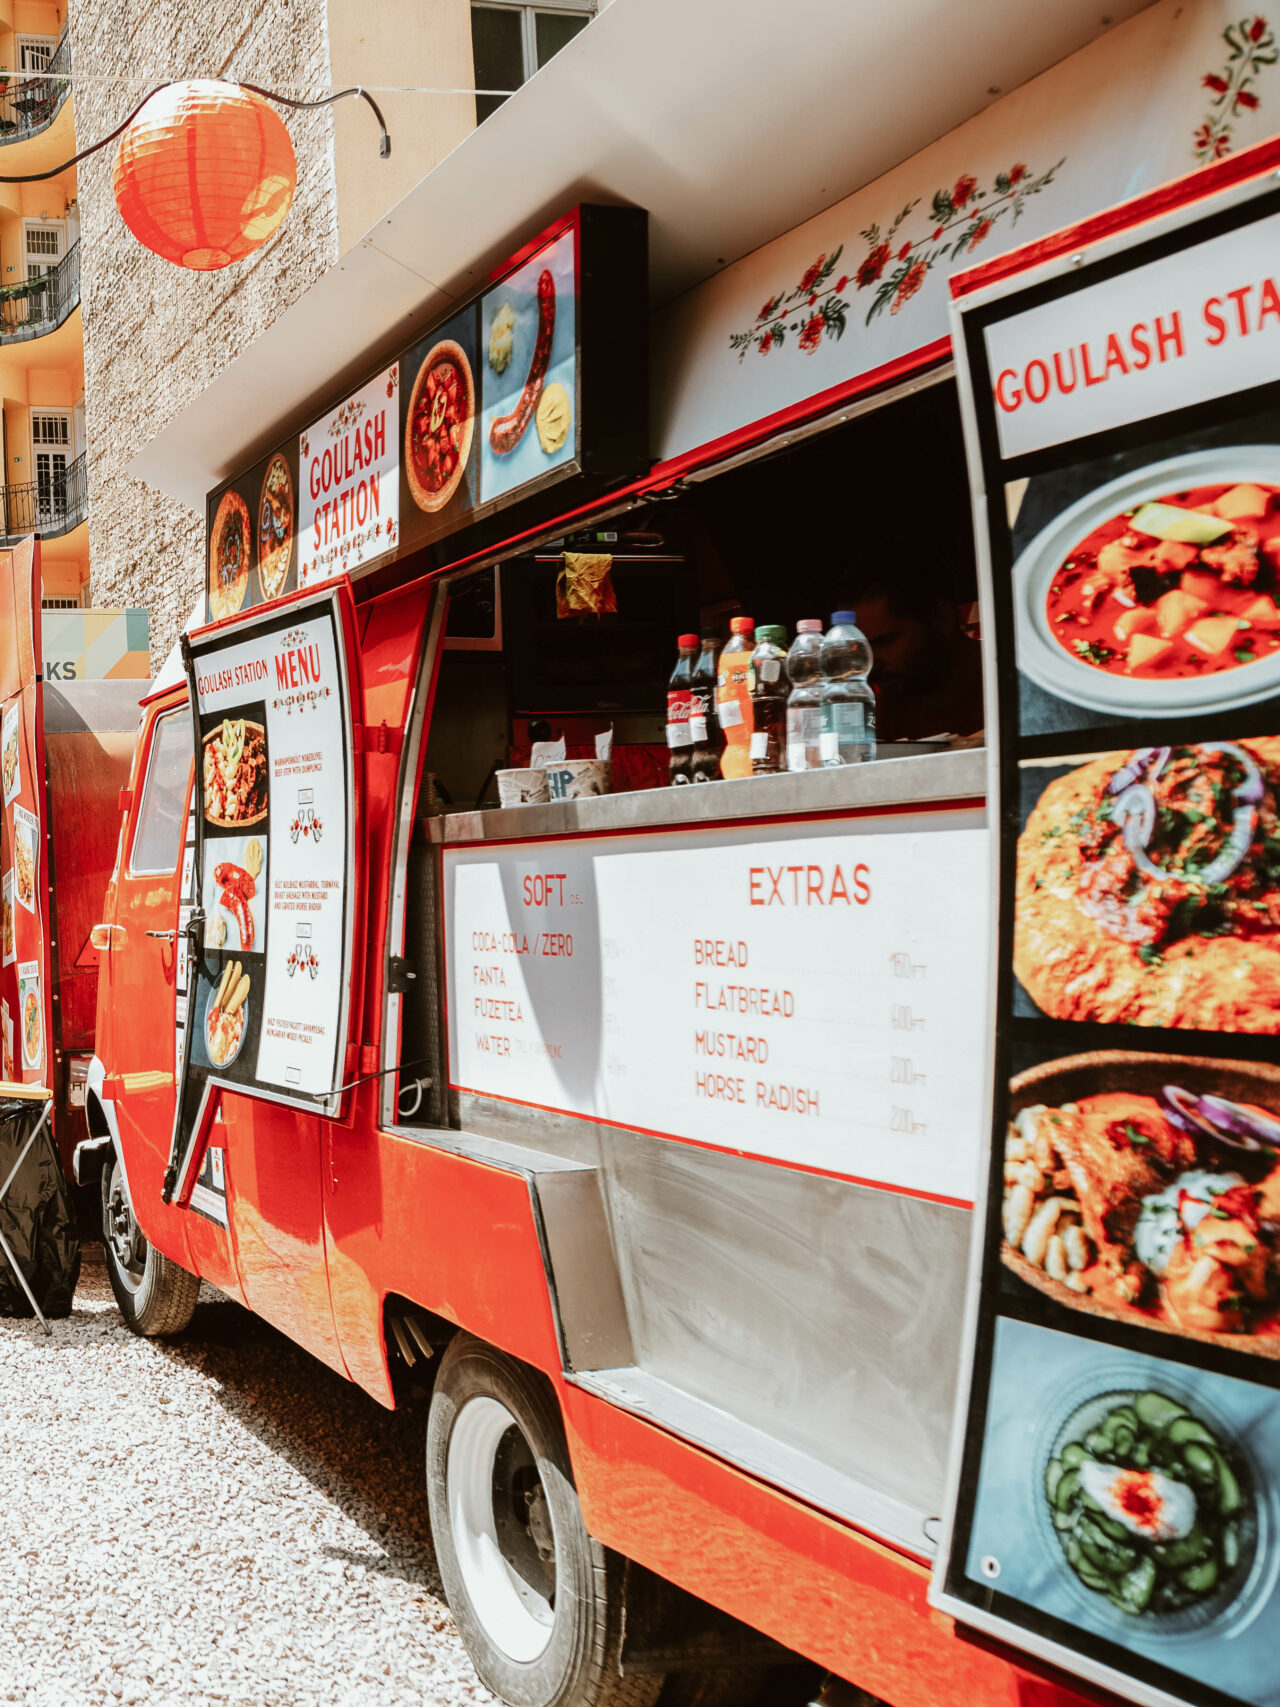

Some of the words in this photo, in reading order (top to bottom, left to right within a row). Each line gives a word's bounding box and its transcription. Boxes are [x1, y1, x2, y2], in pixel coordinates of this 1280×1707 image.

[995, 311, 1186, 413] GOULASH
[1203, 278, 1280, 347] STA
[309, 408, 386, 500] GOULASH
[313, 470, 381, 551] STATION
[42, 661, 77, 681] KS
[198, 669, 233, 696] GOULASH
[234, 658, 269, 686] STATION
[274, 643, 321, 692] MENU
[523, 874, 567, 907] SOFT
[749, 863, 871, 906] EXTRAS
[472, 931, 529, 955] COCA-COLA
[542, 933, 574, 957] ZERO
[694, 939, 748, 968] BREAD
[473, 965, 506, 987] FANTA
[474, 997, 524, 1022] FUZETEA
[695, 982, 794, 1018] FLATBREAD
[475, 1032, 511, 1057] WATER
[695, 1030, 769, 1064] MUSTARD
[695, 1071, 745, 1104] HORSE
[756, 1080, 820, 1117] RADISH
